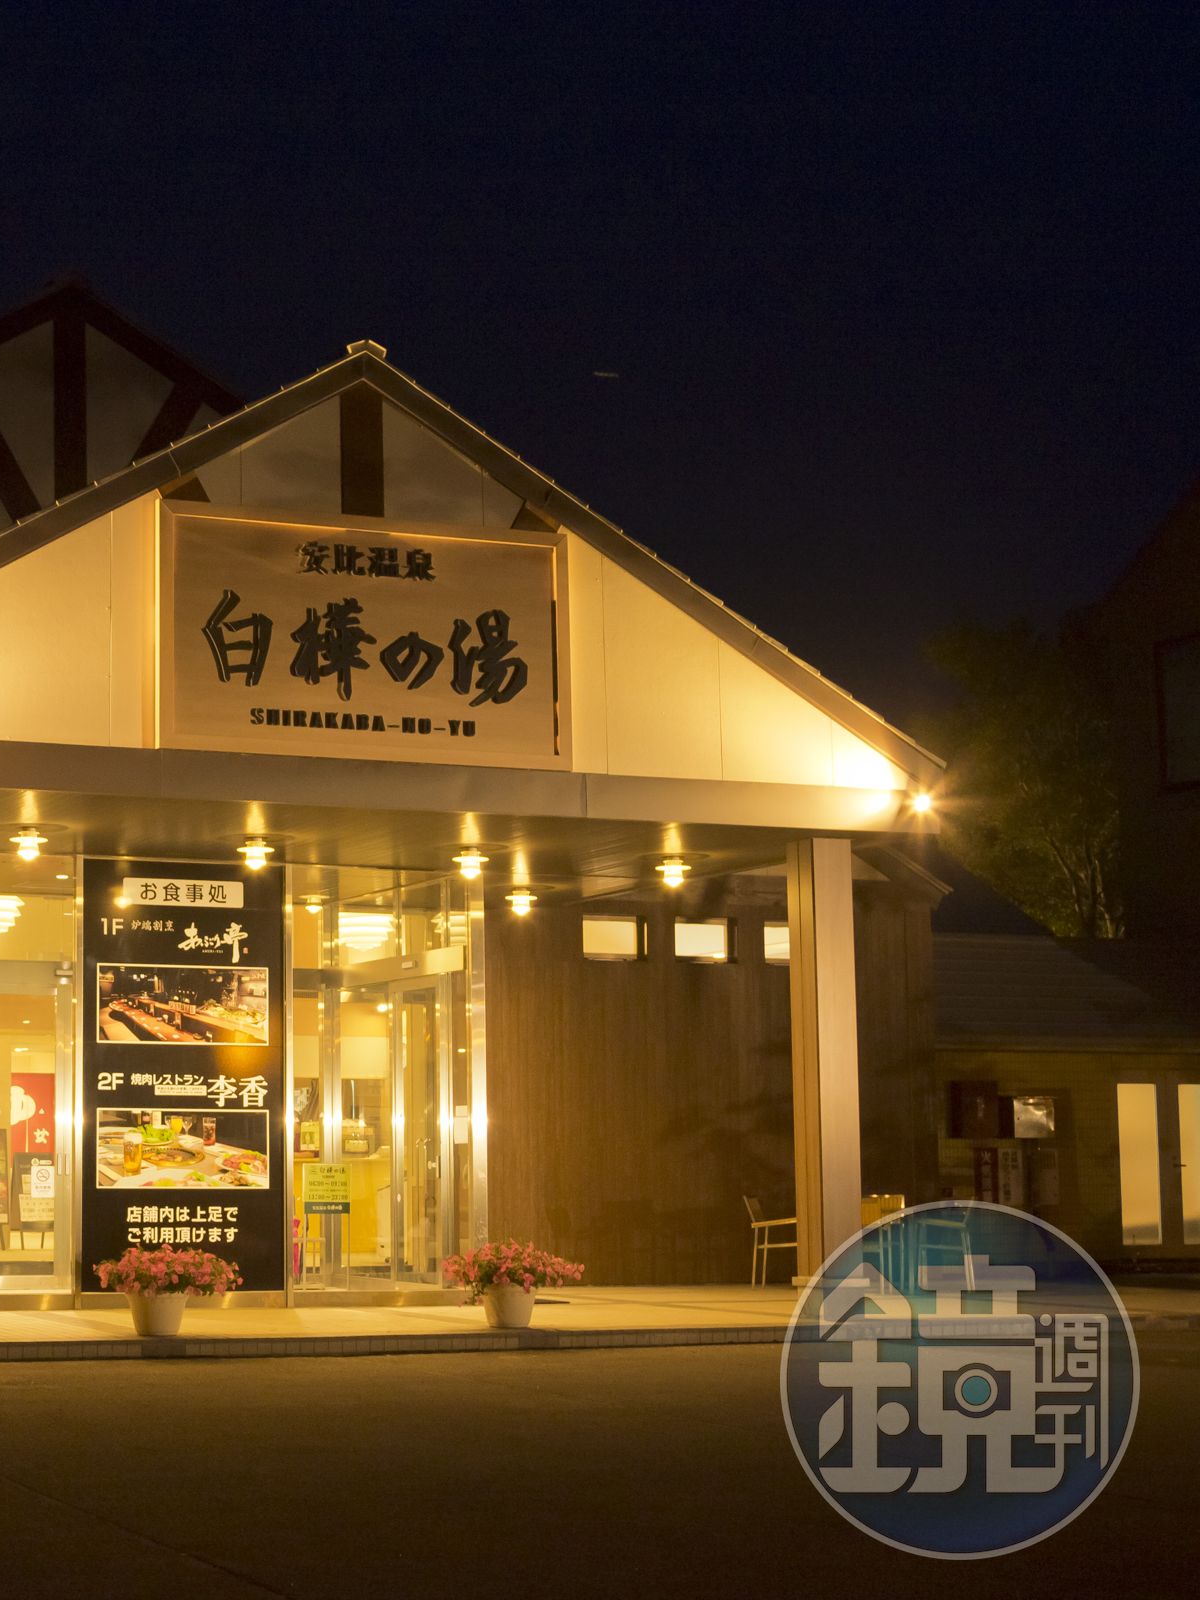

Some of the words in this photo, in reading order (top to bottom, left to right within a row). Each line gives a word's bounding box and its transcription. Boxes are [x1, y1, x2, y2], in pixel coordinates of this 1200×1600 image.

[299, 541, 437, 581] 安比温泉
[201, 589, 529, 707] 白樺の湯
[140, 882, 227, 904] お食事処
[100, 918, 124, 936] 1F
[97, 1072, 125, 1091] 2F
[130, 1073, 205, 1086] 焼肉レストラン
[207, 1075, 269, 1108] 李香
[126, 1206, 239, 1224] 店舗内は上足で
[127, 1226, 239, 1244] ご利用頂けます
